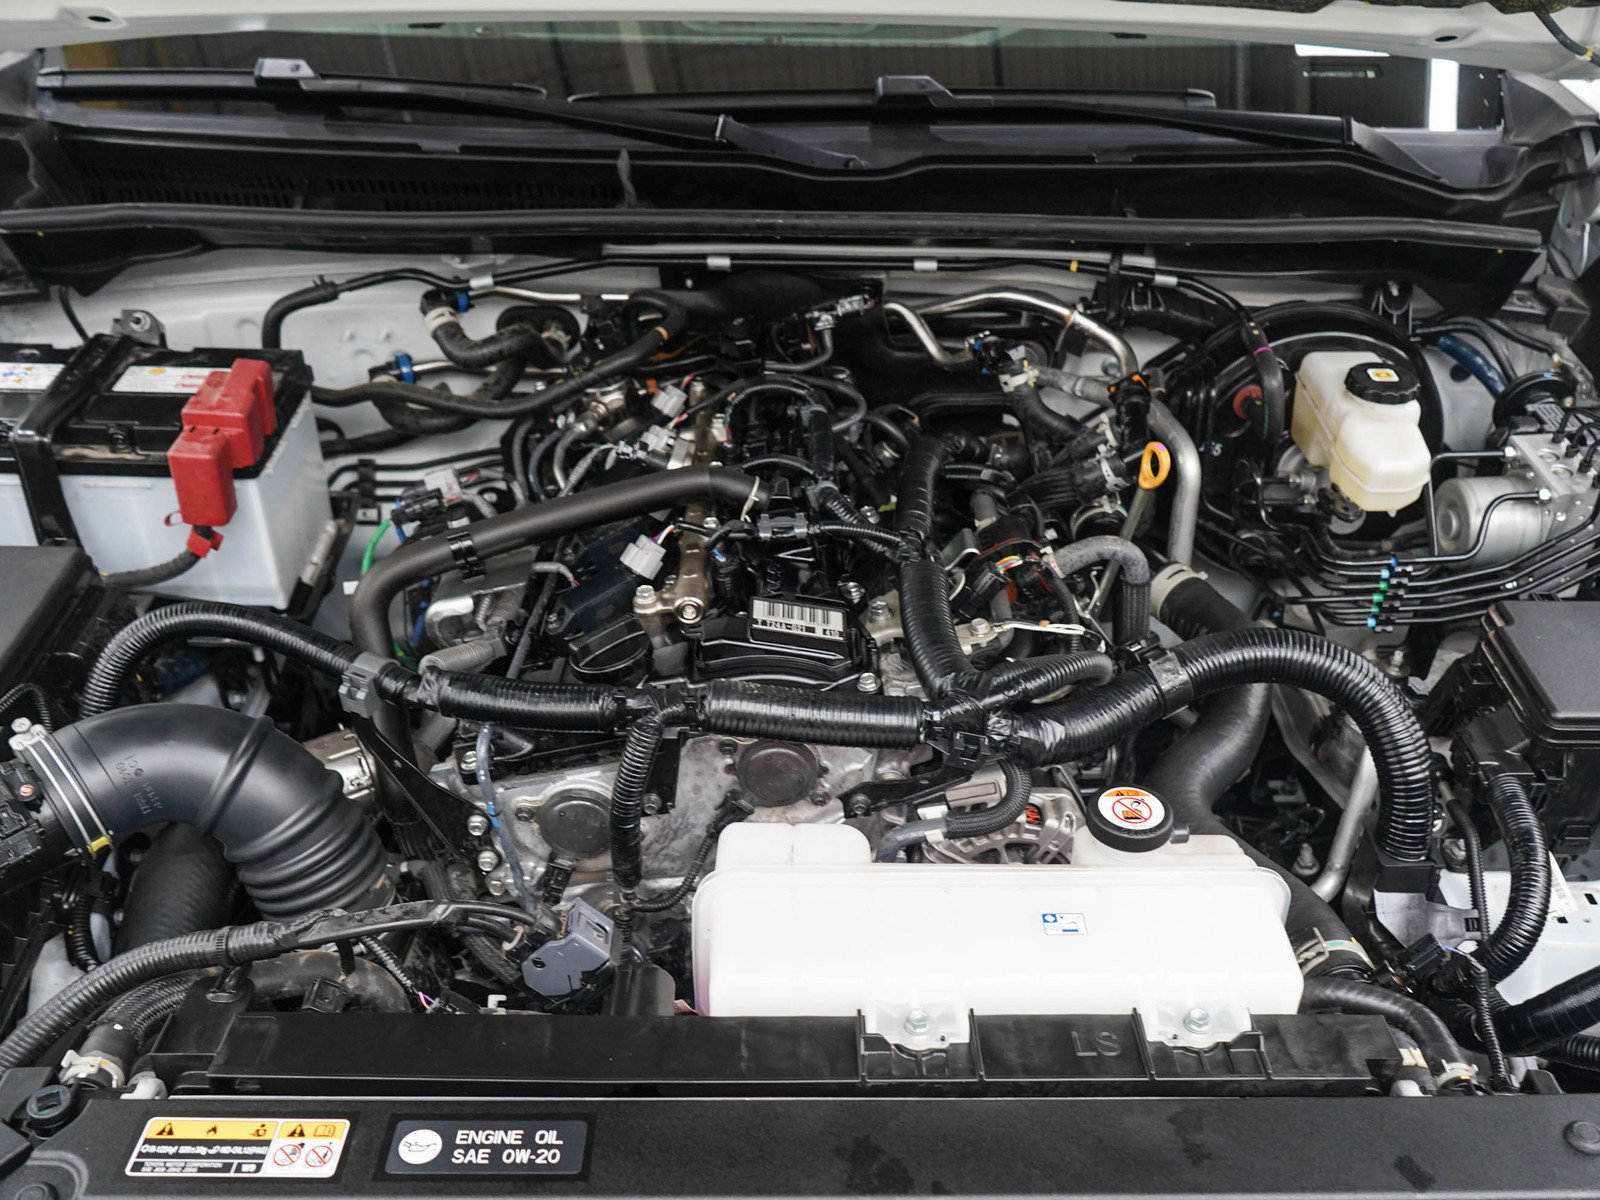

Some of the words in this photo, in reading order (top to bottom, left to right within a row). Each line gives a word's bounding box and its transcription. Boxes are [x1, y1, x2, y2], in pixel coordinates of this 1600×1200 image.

[1071, 1031, 1121, 1056] LS
[455, 1130, 524, 1145] ENGINE
[534, 1130, 564, 1145] OIL
[451, 1149, 491, 1164] SAE
[502, 1149, 561, 1164] 0W-20
